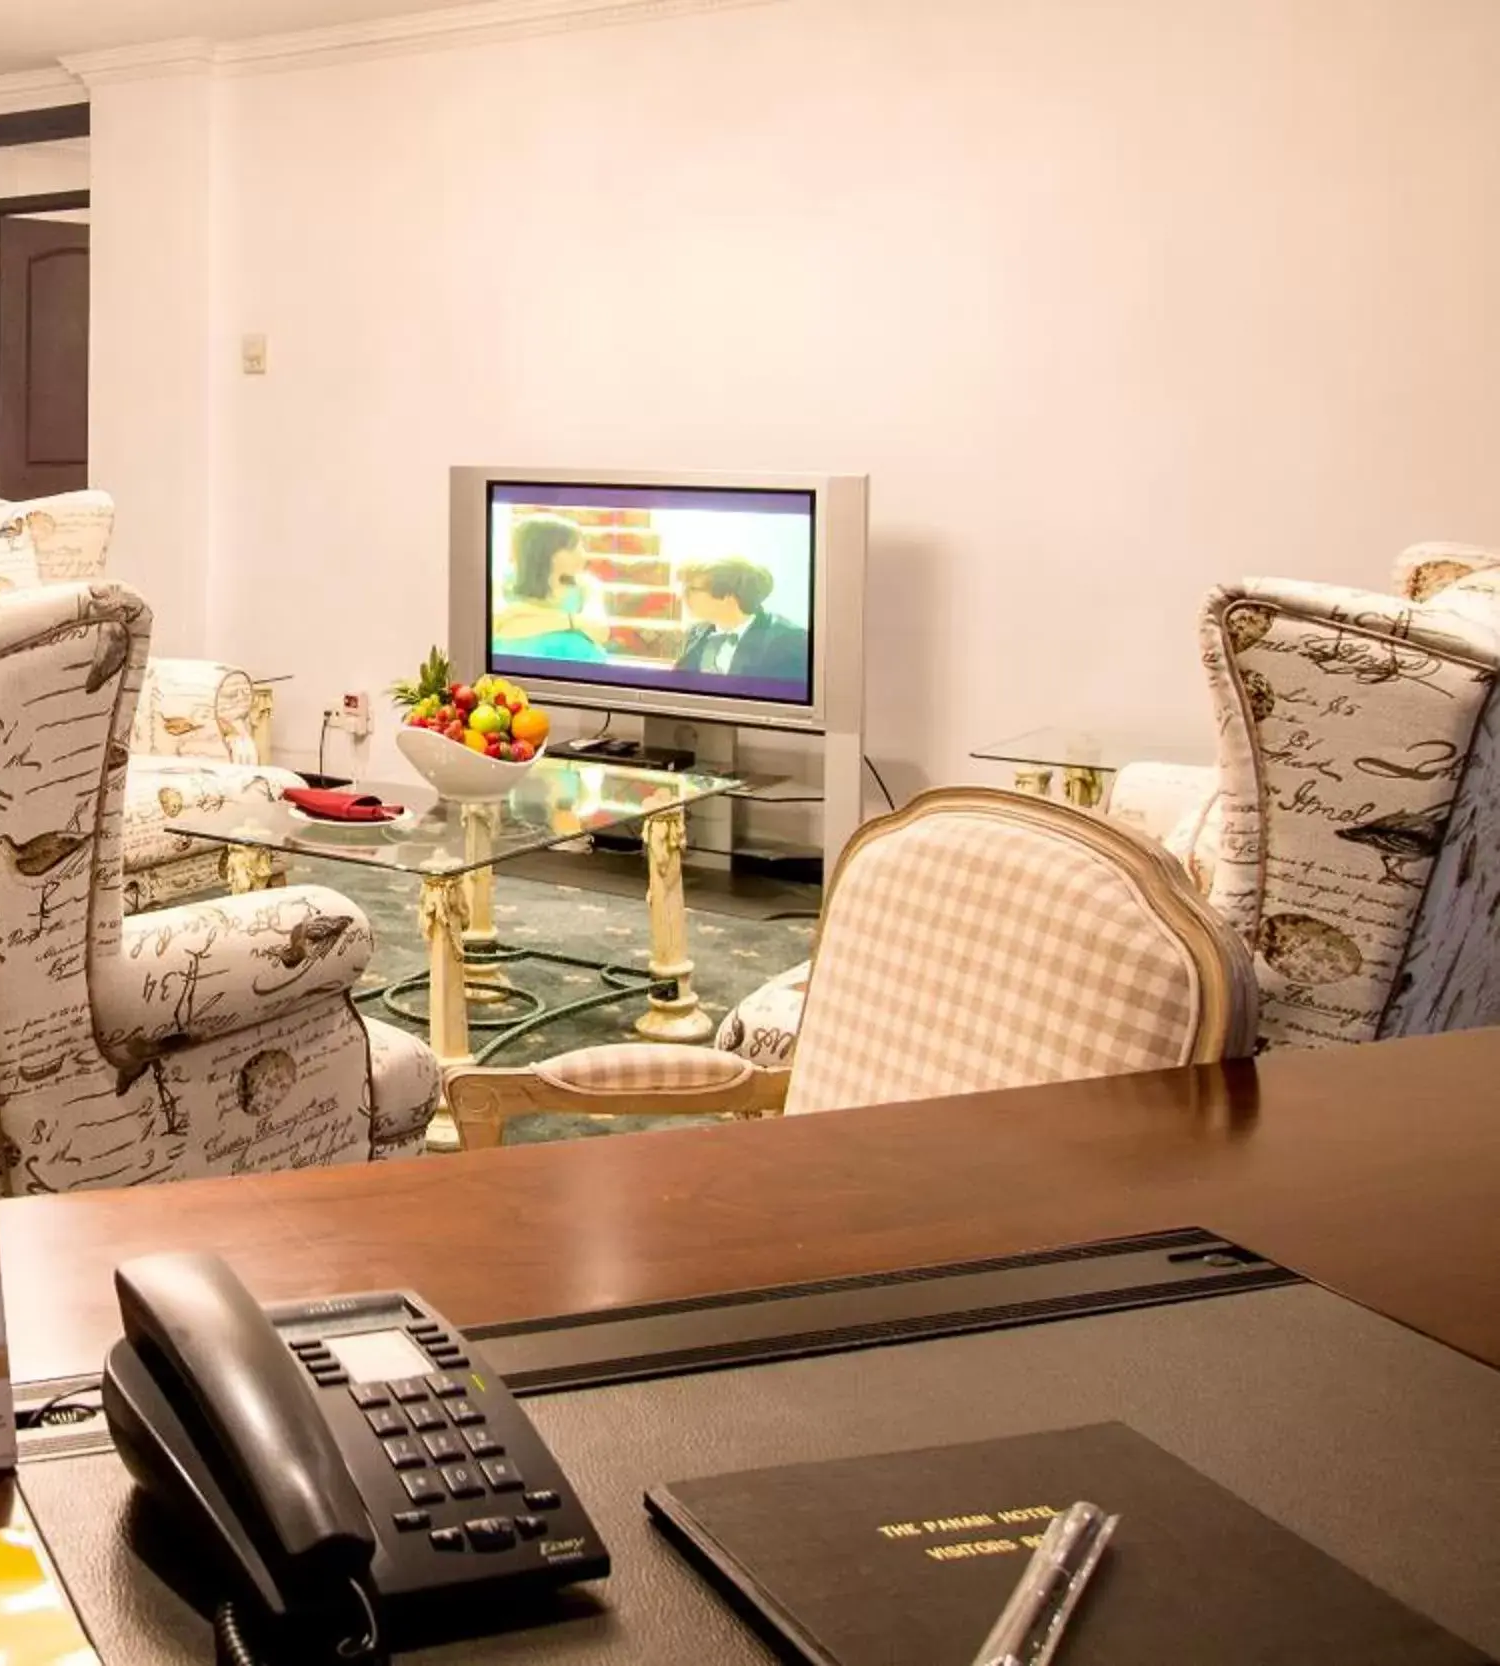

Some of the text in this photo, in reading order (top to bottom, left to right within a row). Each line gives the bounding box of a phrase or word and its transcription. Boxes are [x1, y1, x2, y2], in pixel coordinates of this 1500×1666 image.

[876, 1522, 922, 1538] THE
[997, 1505, 1063, 1524] HOTEL
[924, 1539, 1019, 1561] VISITORS
